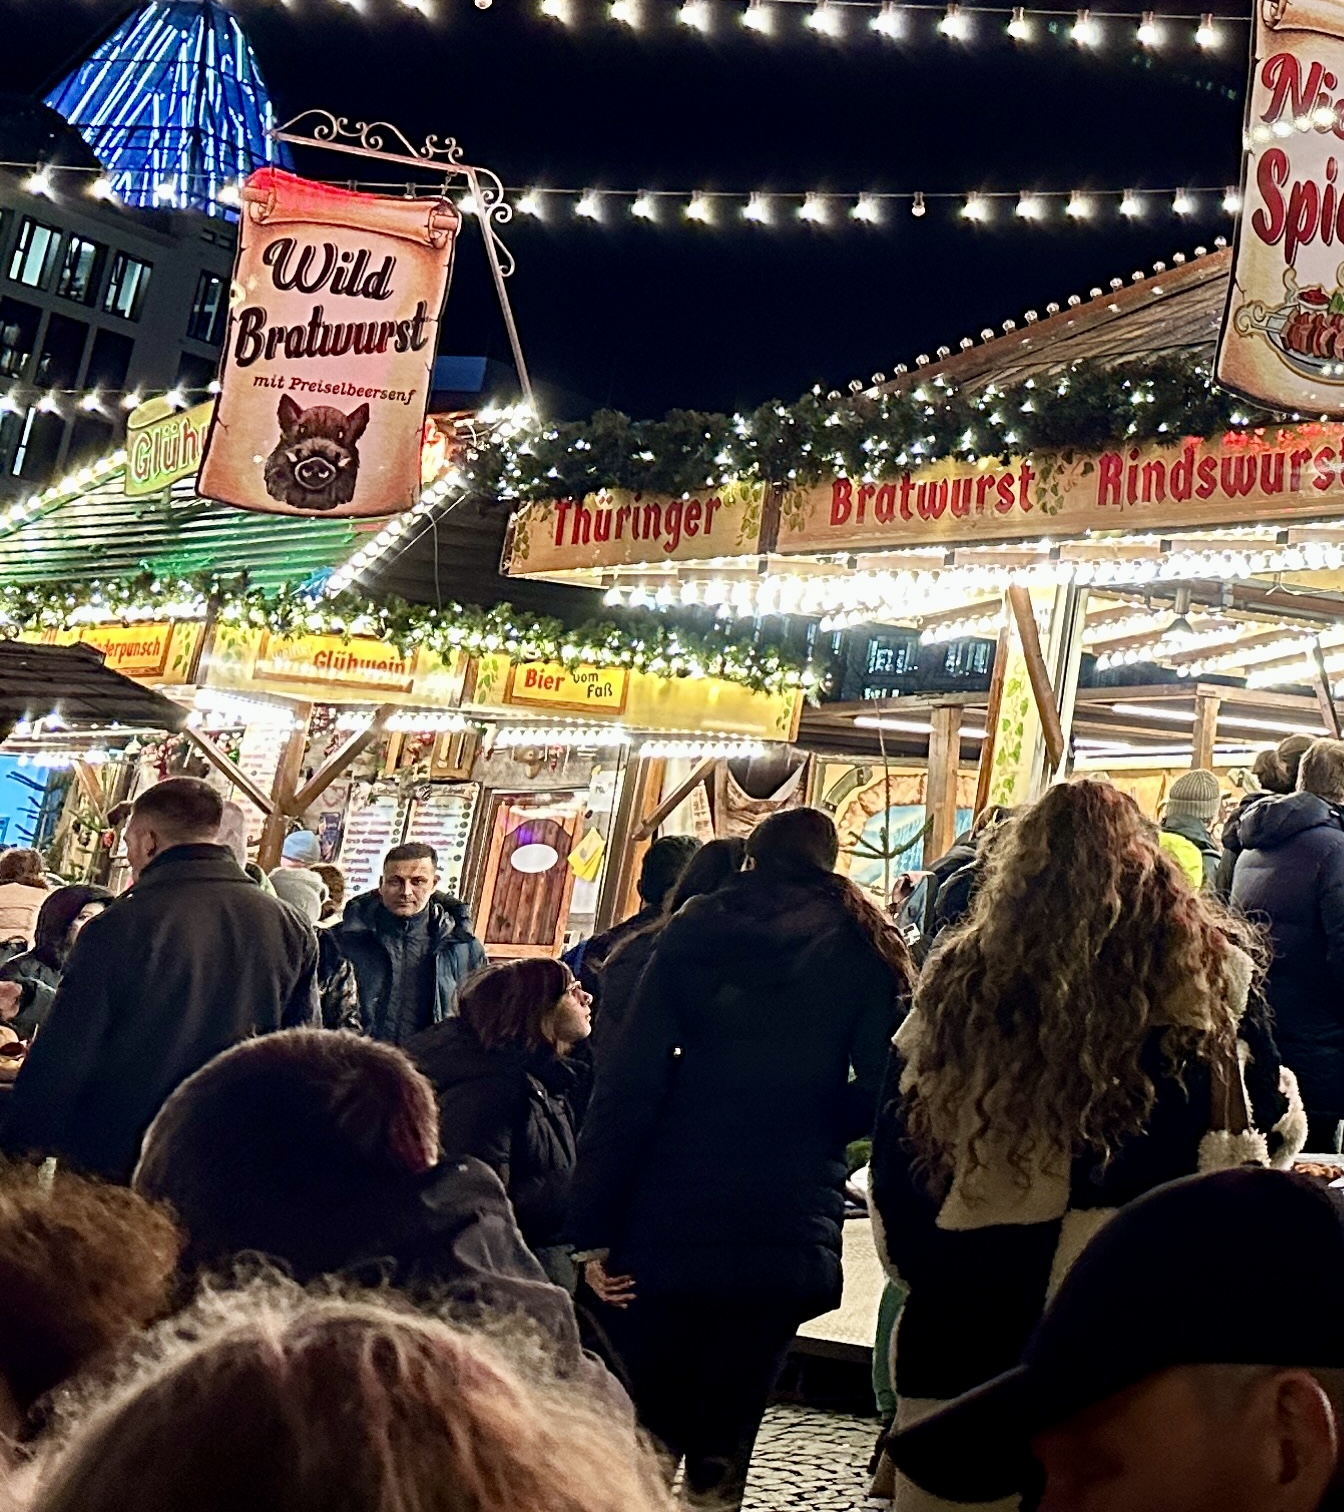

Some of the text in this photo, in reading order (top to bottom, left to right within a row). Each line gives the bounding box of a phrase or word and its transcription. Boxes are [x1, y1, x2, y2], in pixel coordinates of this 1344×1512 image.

[262, 237, 397, 300] Wild
[234, 300, 429, 367] Bratwurst
[253, 374, 416, 405] mit Preiselbeersenf
[554, 493, 721, 553] Thüringer
[829, 463, 1036, 526] Bratwurst
[525, 668, 599, 691] Bier vom
[587, 682, 613, 698] Faß
